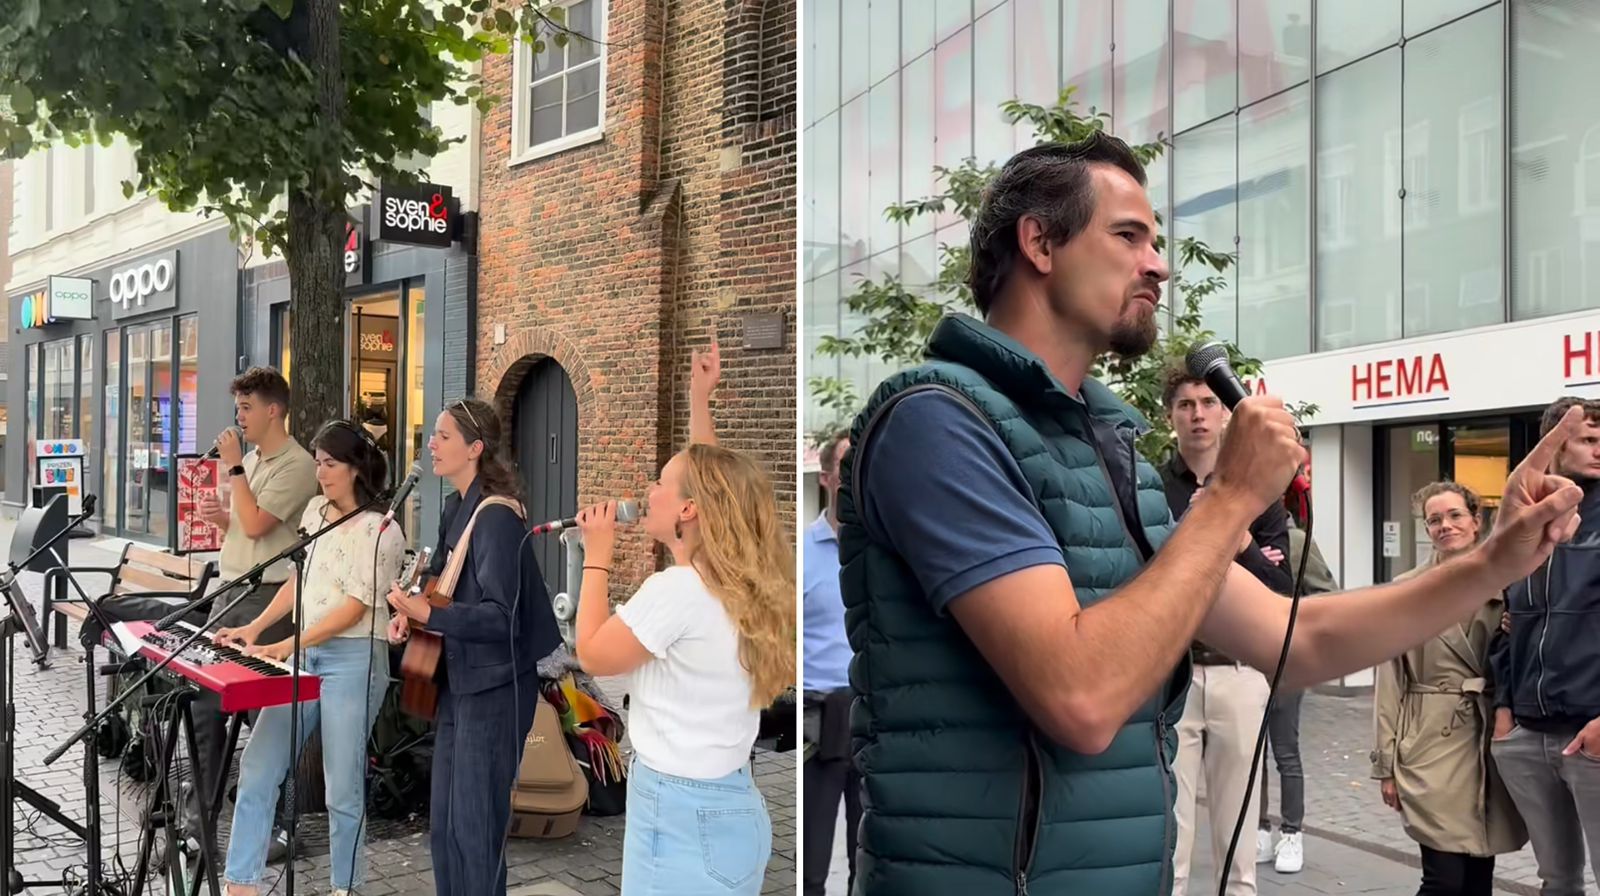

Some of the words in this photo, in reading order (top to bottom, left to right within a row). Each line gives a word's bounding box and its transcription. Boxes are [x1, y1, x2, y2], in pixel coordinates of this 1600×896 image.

[385, 211, 447, 234] sophie
[54, 290, 89, 301] oppo
[109, 258, 173, 310] oppo
[1351, 353, 1449, 401] HEMA
